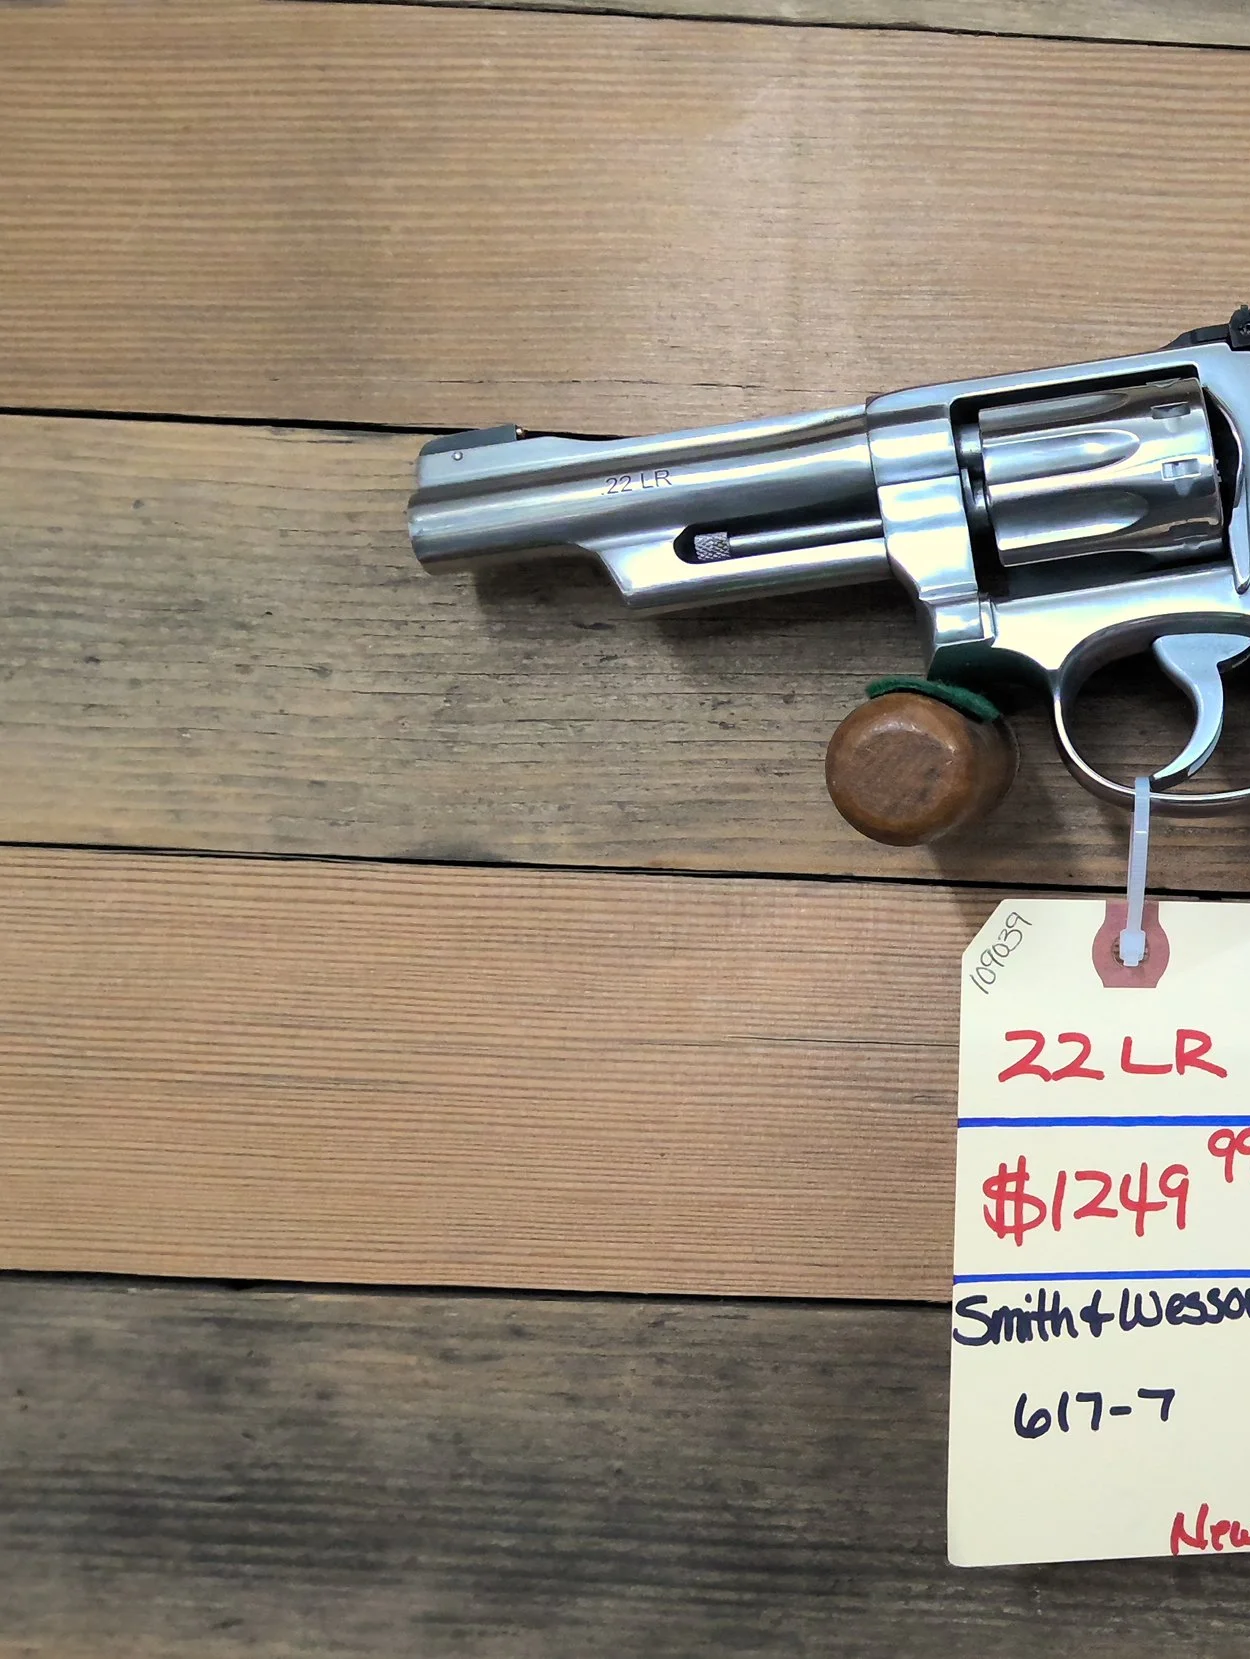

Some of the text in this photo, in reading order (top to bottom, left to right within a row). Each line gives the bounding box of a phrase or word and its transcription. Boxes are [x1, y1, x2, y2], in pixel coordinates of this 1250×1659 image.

[641, 469, 672, 489] LR
[970, 911, 1032, 994] 109039
[998, 1028, 1228, 1083] 22 LR
[982, 1155, 1190, 1247] $1249
[953, 1287, 1079, 1346] Smith
[1014, 1388, 1175, 1439] 617-7
